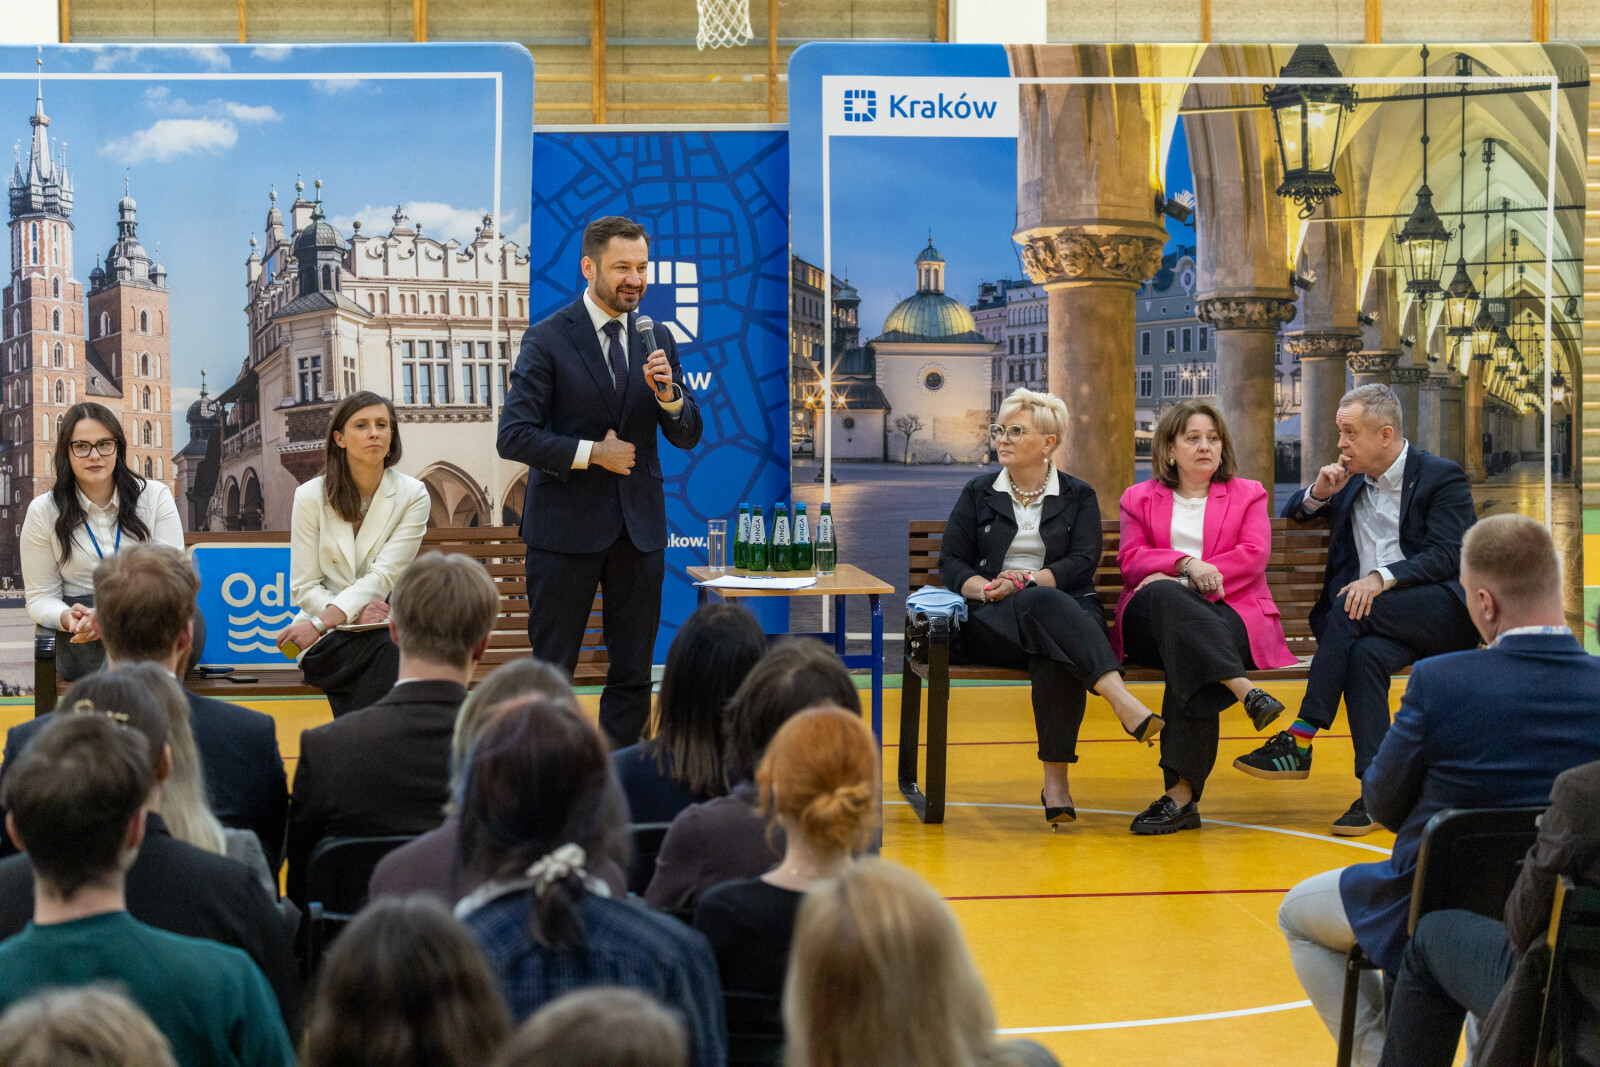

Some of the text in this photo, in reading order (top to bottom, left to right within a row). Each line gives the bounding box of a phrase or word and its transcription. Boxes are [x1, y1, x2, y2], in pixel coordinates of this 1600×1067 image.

[890, 92, 997, 119] Kraków
[667, 533, 710, 550] kow.
[221, 572, 299, 608] Od
